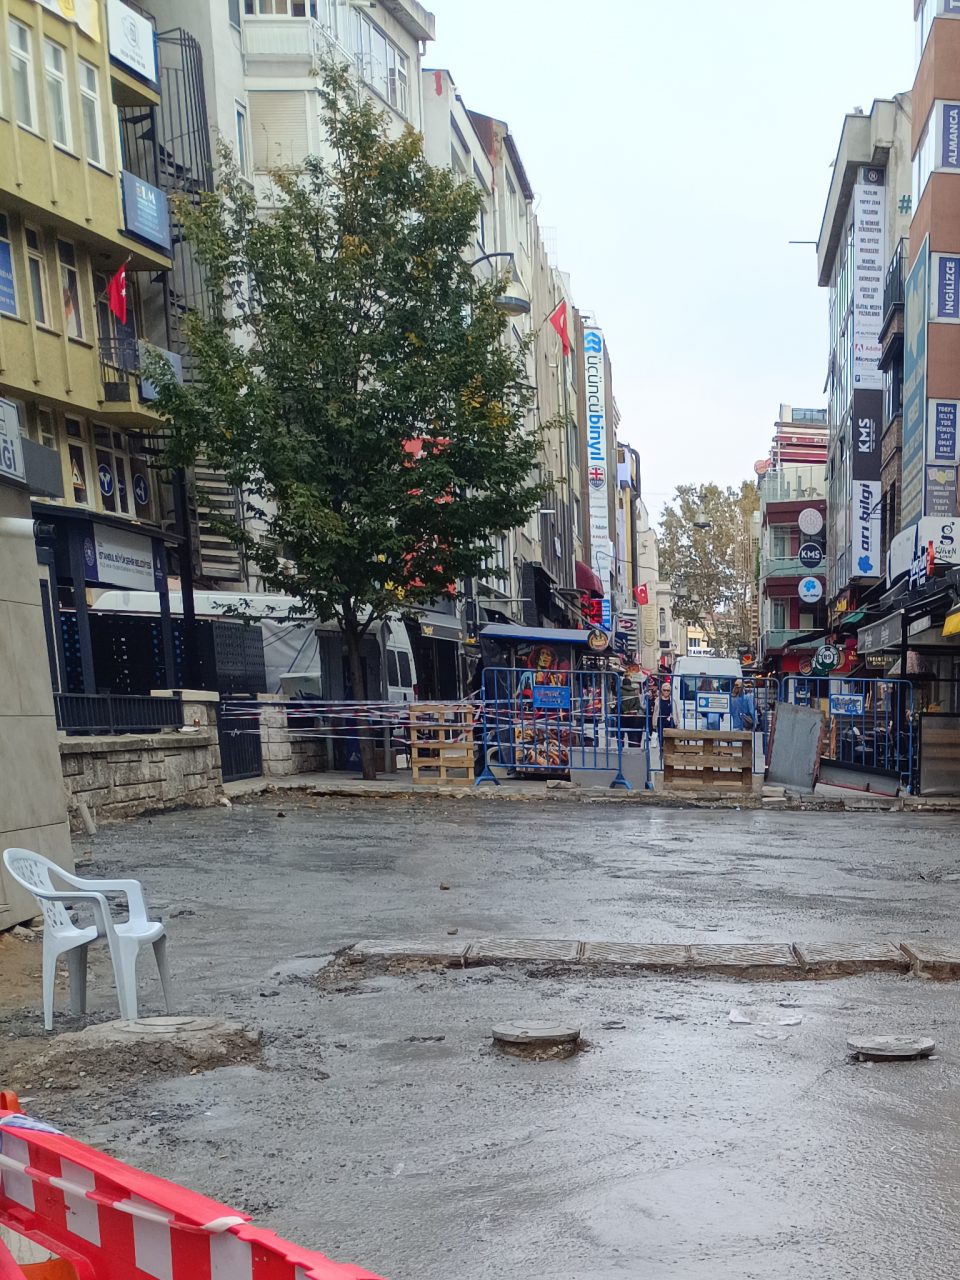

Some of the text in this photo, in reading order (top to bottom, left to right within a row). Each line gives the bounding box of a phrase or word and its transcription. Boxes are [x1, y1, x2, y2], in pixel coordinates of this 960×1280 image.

[948, 109, 958, 165] ALMANCA
[944, 261, 955, 314] İNGİLİZCE
[859, 418, 870, 452] KMS
[801, 550, 820, 559] KMS
